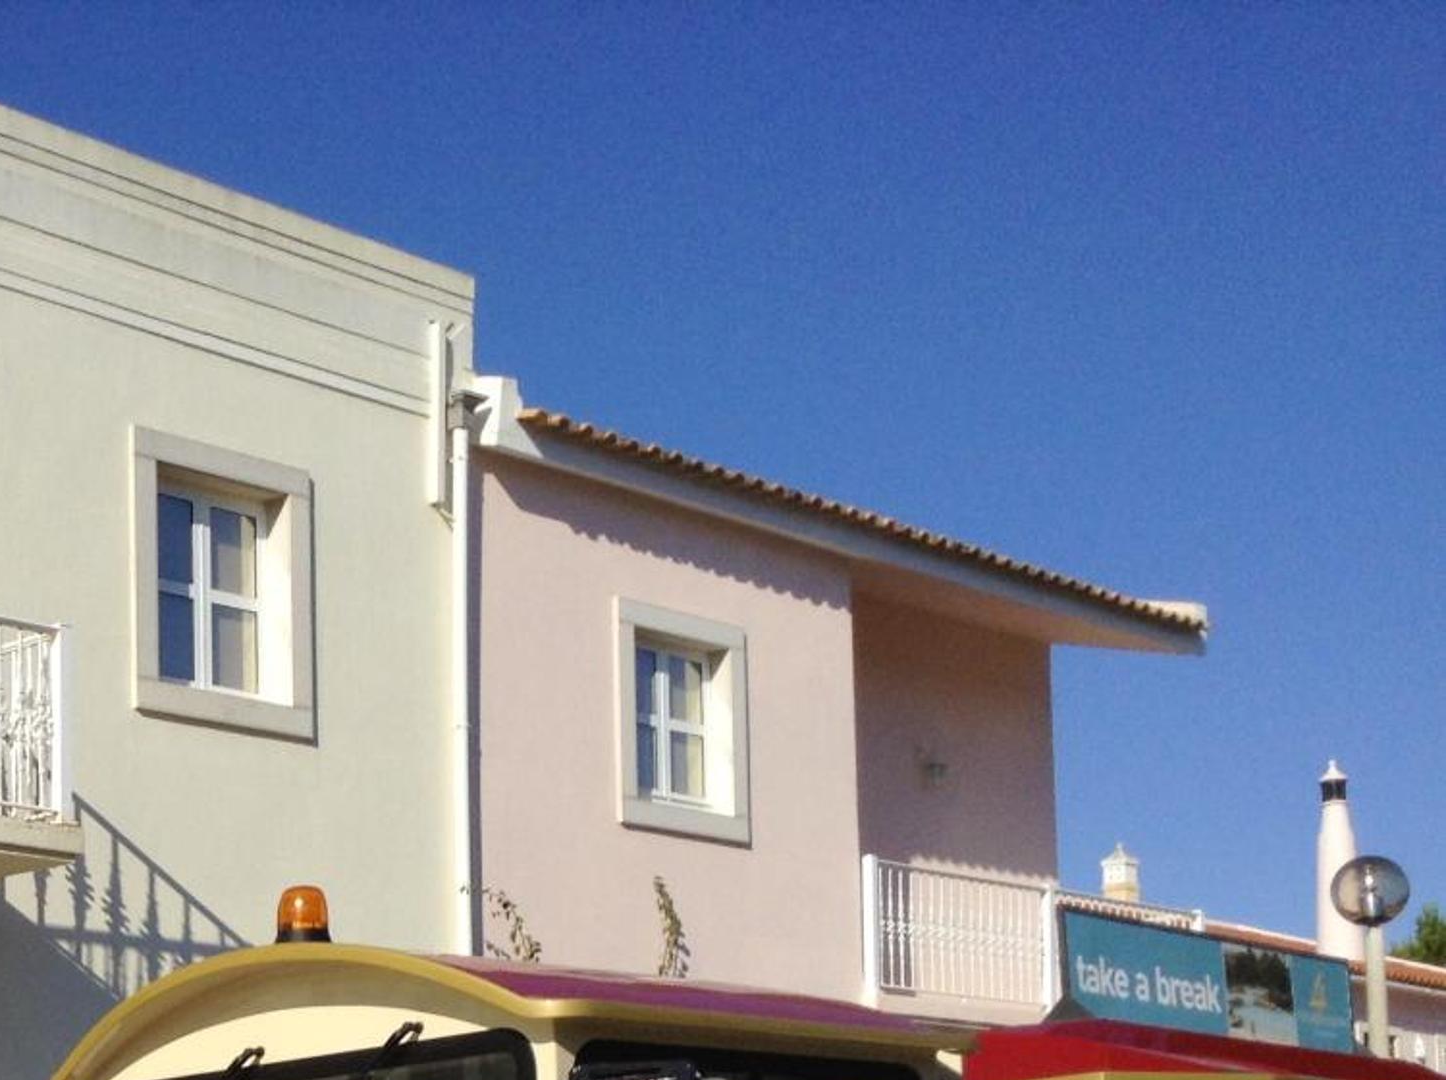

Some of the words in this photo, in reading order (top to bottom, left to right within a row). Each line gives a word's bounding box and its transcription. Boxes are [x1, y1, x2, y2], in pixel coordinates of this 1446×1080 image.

[1076, 955, 1130, 999] take
[1135, 971, 1150, 1003] a
[1155, 966, 1222, 1013] break
